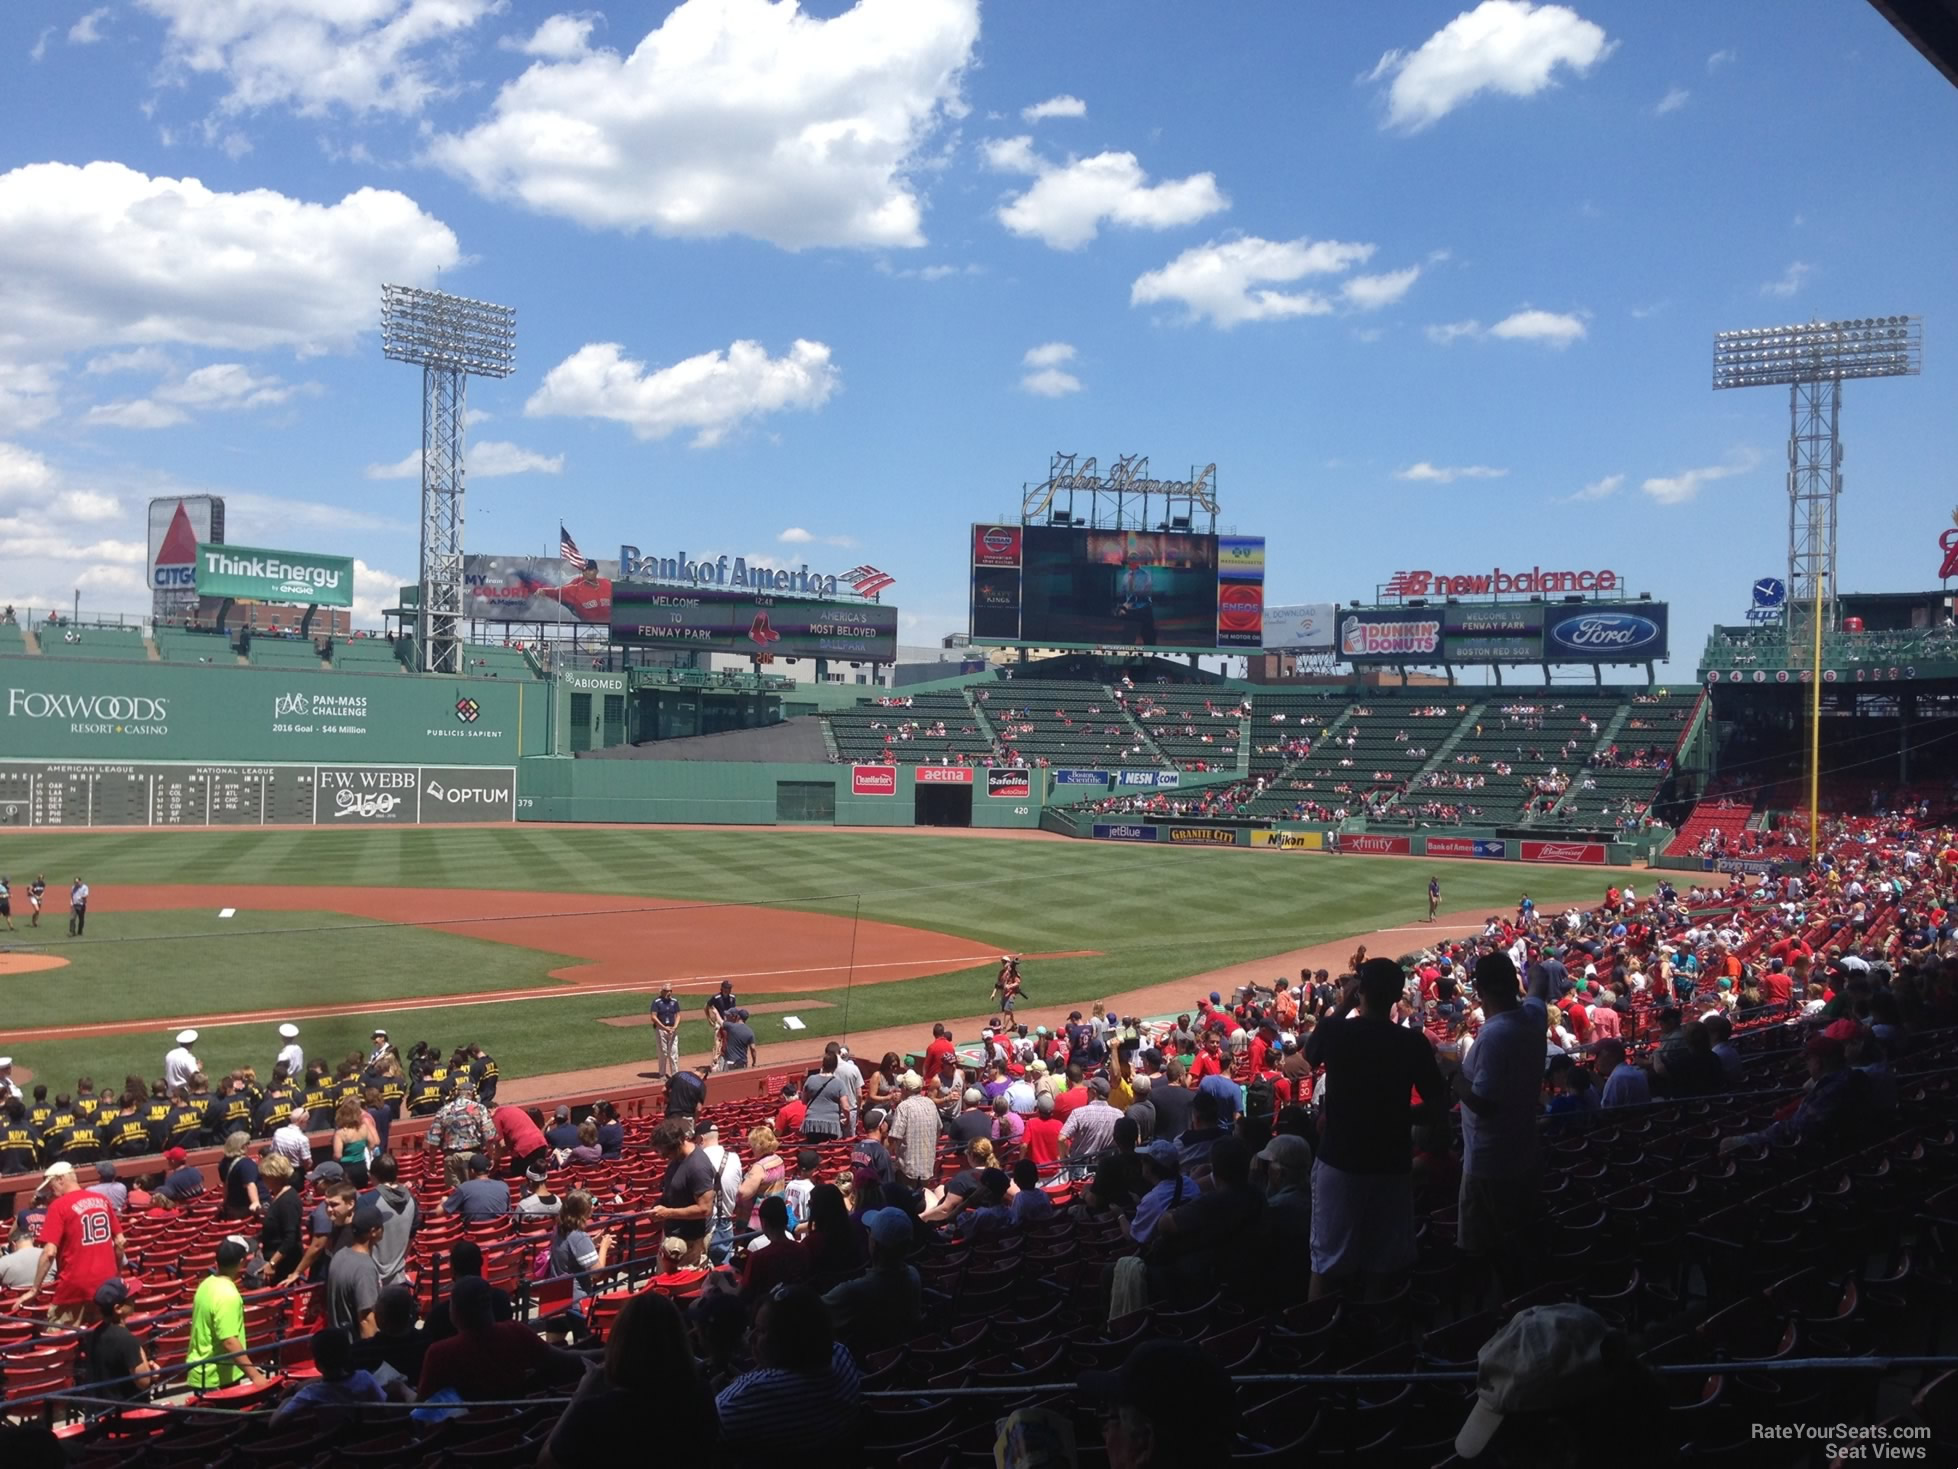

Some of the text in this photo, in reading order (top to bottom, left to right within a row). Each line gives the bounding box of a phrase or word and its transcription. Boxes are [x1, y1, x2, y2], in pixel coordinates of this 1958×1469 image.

[1022, 451, 1221, 518] John Hancock
[985, 536, 1011, 544] NISSAN
[205, 553, 339, 588] ThinkEnergy
[621, 545, 837, 595] Bank of America
[465, 575, 486, 586] MY
[1434, 566, 1616, 596] new balance
[652, 596, 699, 608] WELCOME
[670, 612, 682, 623] TO
[820, 611, 867, 623] AMERICA'S
[1273, 608, 1316, 618] DOWNLOAD
[1467, 612, 1521, 620] WELCOME TO
[810, 624, 876, 637] MOST BELOVED
[1368, 622, 1437, 638] DUNKIN'
[1462, 621, 1525, 631] FENWAY PARK
[1572, 619, 1637, 644] Ford
[638, 625, 711, 640] FENWAY PARK
[1368, 637, 1434, 652] DONUTS
[1456, 647, 1530, 656] BOSTON RED SOX
[574, 679, 622, 690] ABIOMED
[8, 688, 166, 721] FOXWOODS
[313, 695, 367, 707] PAN-MASS
[313, 707, 367, 717] CHALLENGE
[71, 723, 167, 735] RESORT CASINO
[272, 724, 366, 735] 2016 Goal $46 Million
[47, 765, 134, 774] AMERICAN LEAGUE
[197, 767, 238, 775] NATIONAL
[924, 768, 964, 781] aetna
[1072, 770, 1094, 778] Boston
[321, 772, 415, 788] F.W. WEBB
[989, 777, 1028, 786] Safelite
[1067, 775, 1102, 784] Scientific
[1125, 772, 1153, 785] NESN
[447, 788, 508, 803] OPTUM
[354, 792, 394, 817] 150
[518, 799, 533, 807] 379
[1014, 807, 1029, 815] 420
[1109, 826, 1140, 838] jetBlue
[1171, 829, 1212, 840] GRANITE
[1213, 831, 1236, 843] CITY
[1268, 834, 1304, 846] Nikon
[1352, 836, 1393, 850] xfinity
[1428, 842, 1446, 850] Bank
[1453, 844, 1483, 853] America
[1543, 846, 1583, 857] Budweiser
[306, 1091, 323, 1103] NAVY
[1300, 1087, 1310, 1096] 30
[152, 1105, 171, 1115] NAVY
[274, 1103, 291, 1115] NAVY
[179, 1112, 197, 1124] NAVY
[123, 1122, 141, 1133] NAVY
[8, 1130, 29, 1140] NAVY
[73, 1130, 94, 1141] NAVY
[81, 1211, 112, 1245] 18
